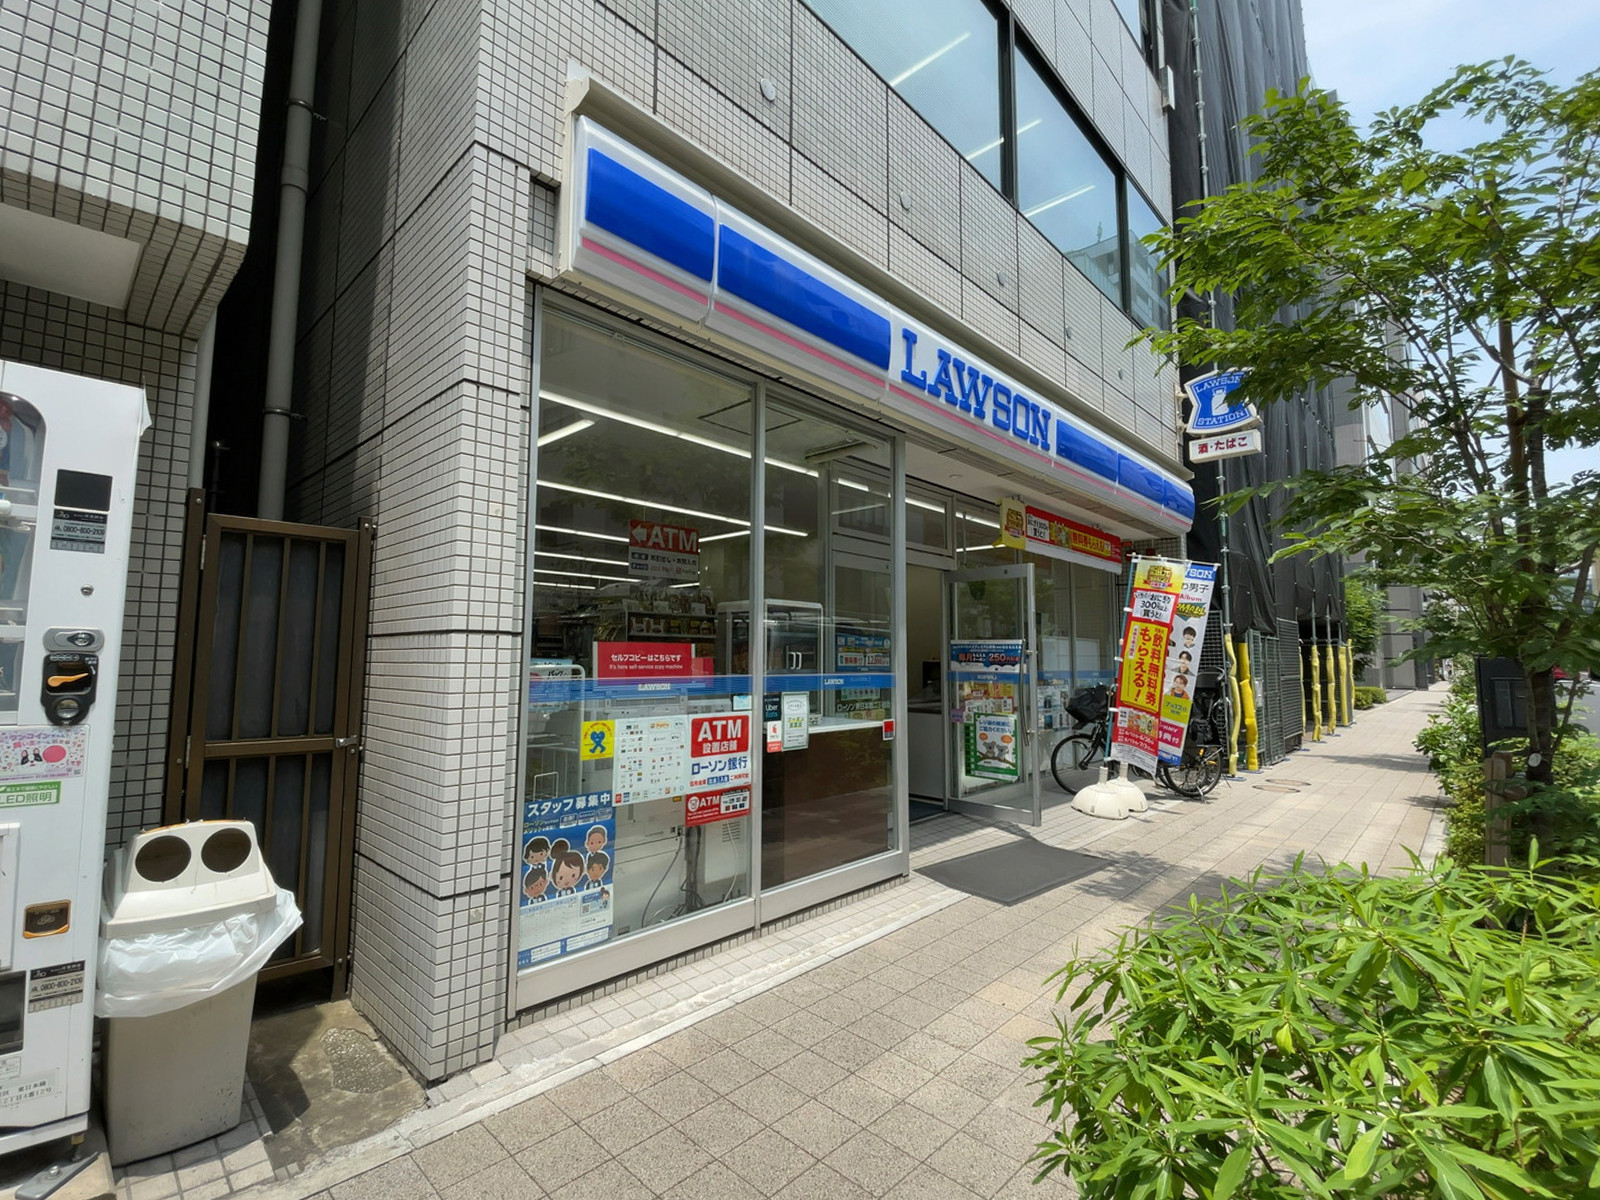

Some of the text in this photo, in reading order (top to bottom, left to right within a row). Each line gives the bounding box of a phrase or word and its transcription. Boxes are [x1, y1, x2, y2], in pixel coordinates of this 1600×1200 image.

[901, 327, 1052, 451] LAWSON
[1197, 409, 1245, 426] STATION
[647, 525, 697, 552] ATM
[611, 653, 682, 662] セルフコピーはこちらです
[637, 683, 671, 691] LAWSON
[697, 719, 742, 742] ATM
[702, 740, 738, 755] 設置店舗
[691, 756, 748, 776] ローソン銀行
[527, 793, 611, 818] スタッフ募集中
[699, 795, 720, 808] ATM
